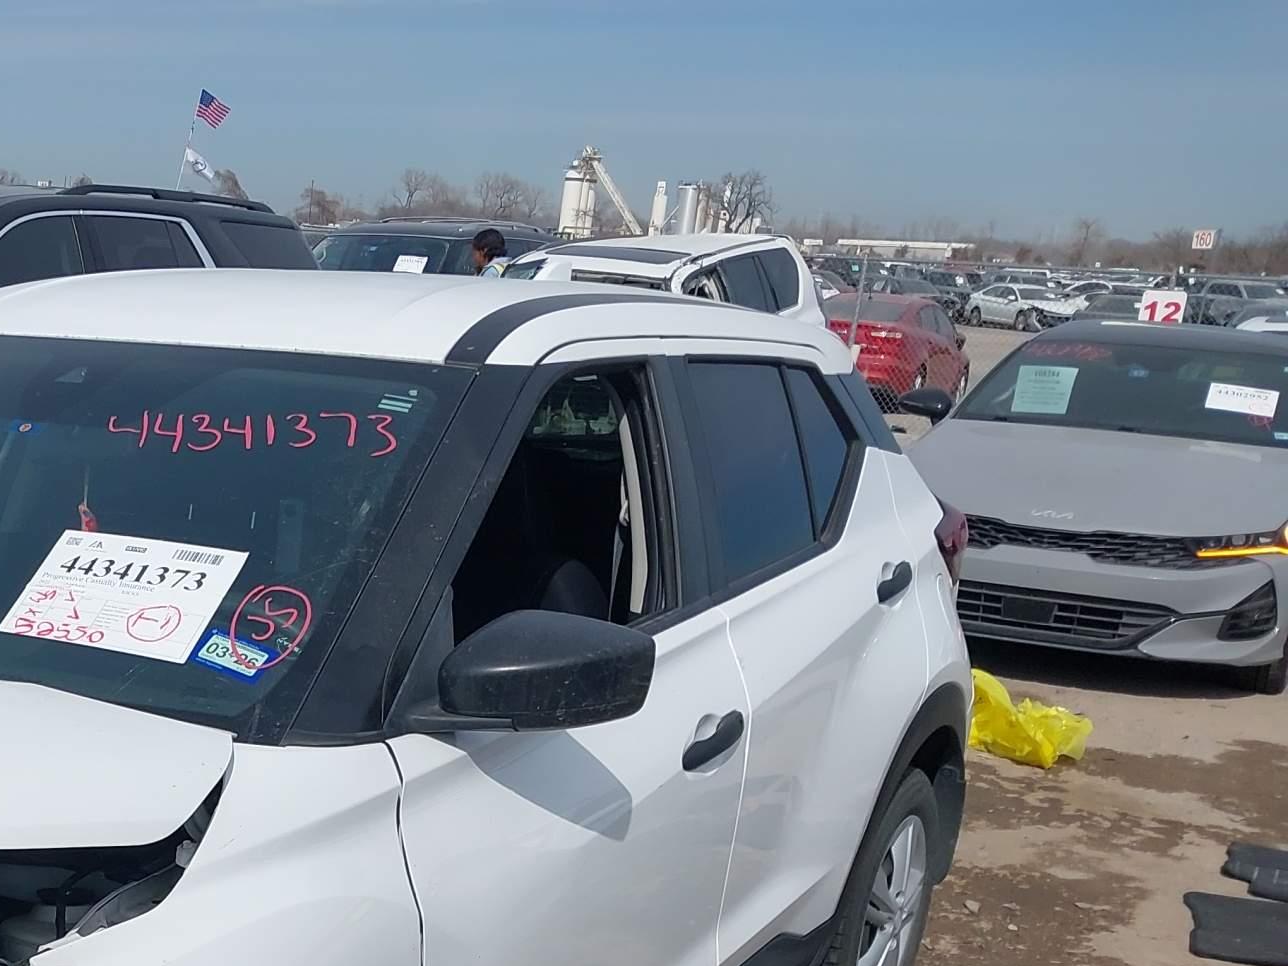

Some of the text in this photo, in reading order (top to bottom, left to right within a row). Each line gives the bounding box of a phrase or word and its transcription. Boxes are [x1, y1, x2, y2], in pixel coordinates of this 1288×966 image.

[1195, 231, 1212, 247] 160
[1144, 301, 1182, 325] 12
[108, 410, 397, 457] 44341373
[60, 555, 208, 591] 44341373
